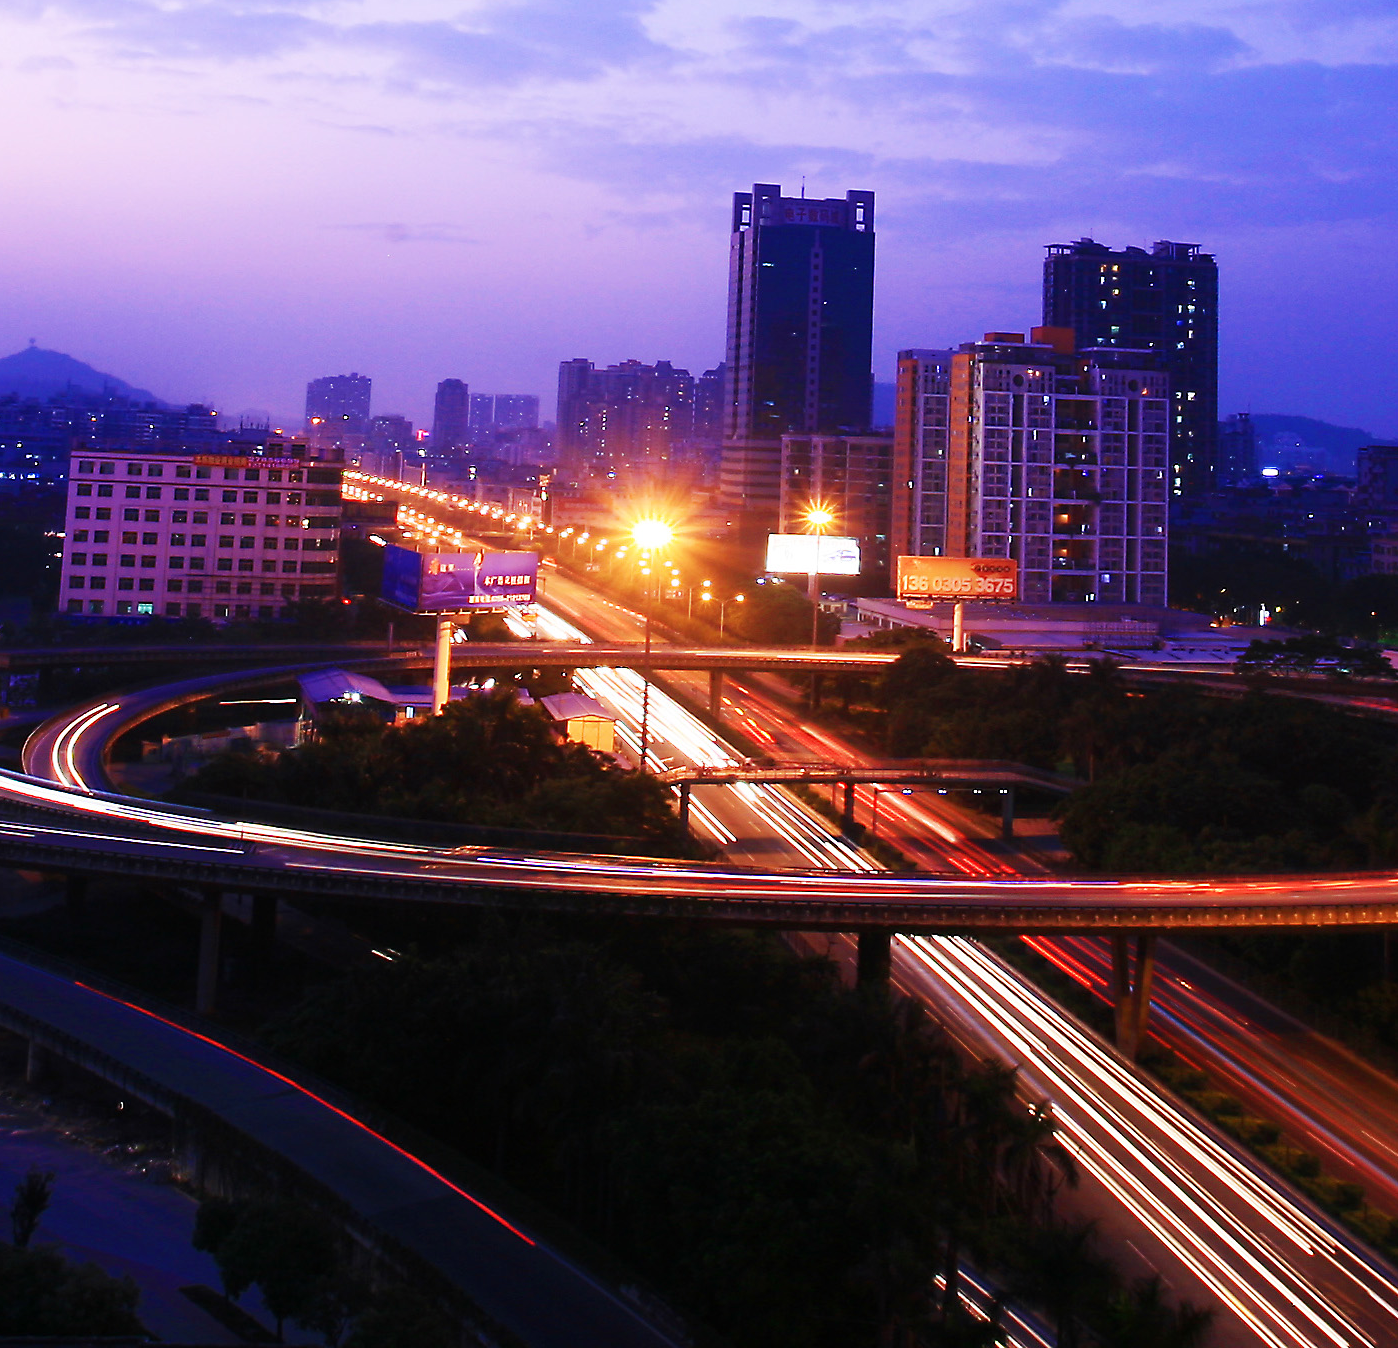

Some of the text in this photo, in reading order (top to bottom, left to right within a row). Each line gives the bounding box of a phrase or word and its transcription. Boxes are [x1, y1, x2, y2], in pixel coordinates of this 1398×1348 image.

[901, 574, 1014, 594] 136 0305 3675
